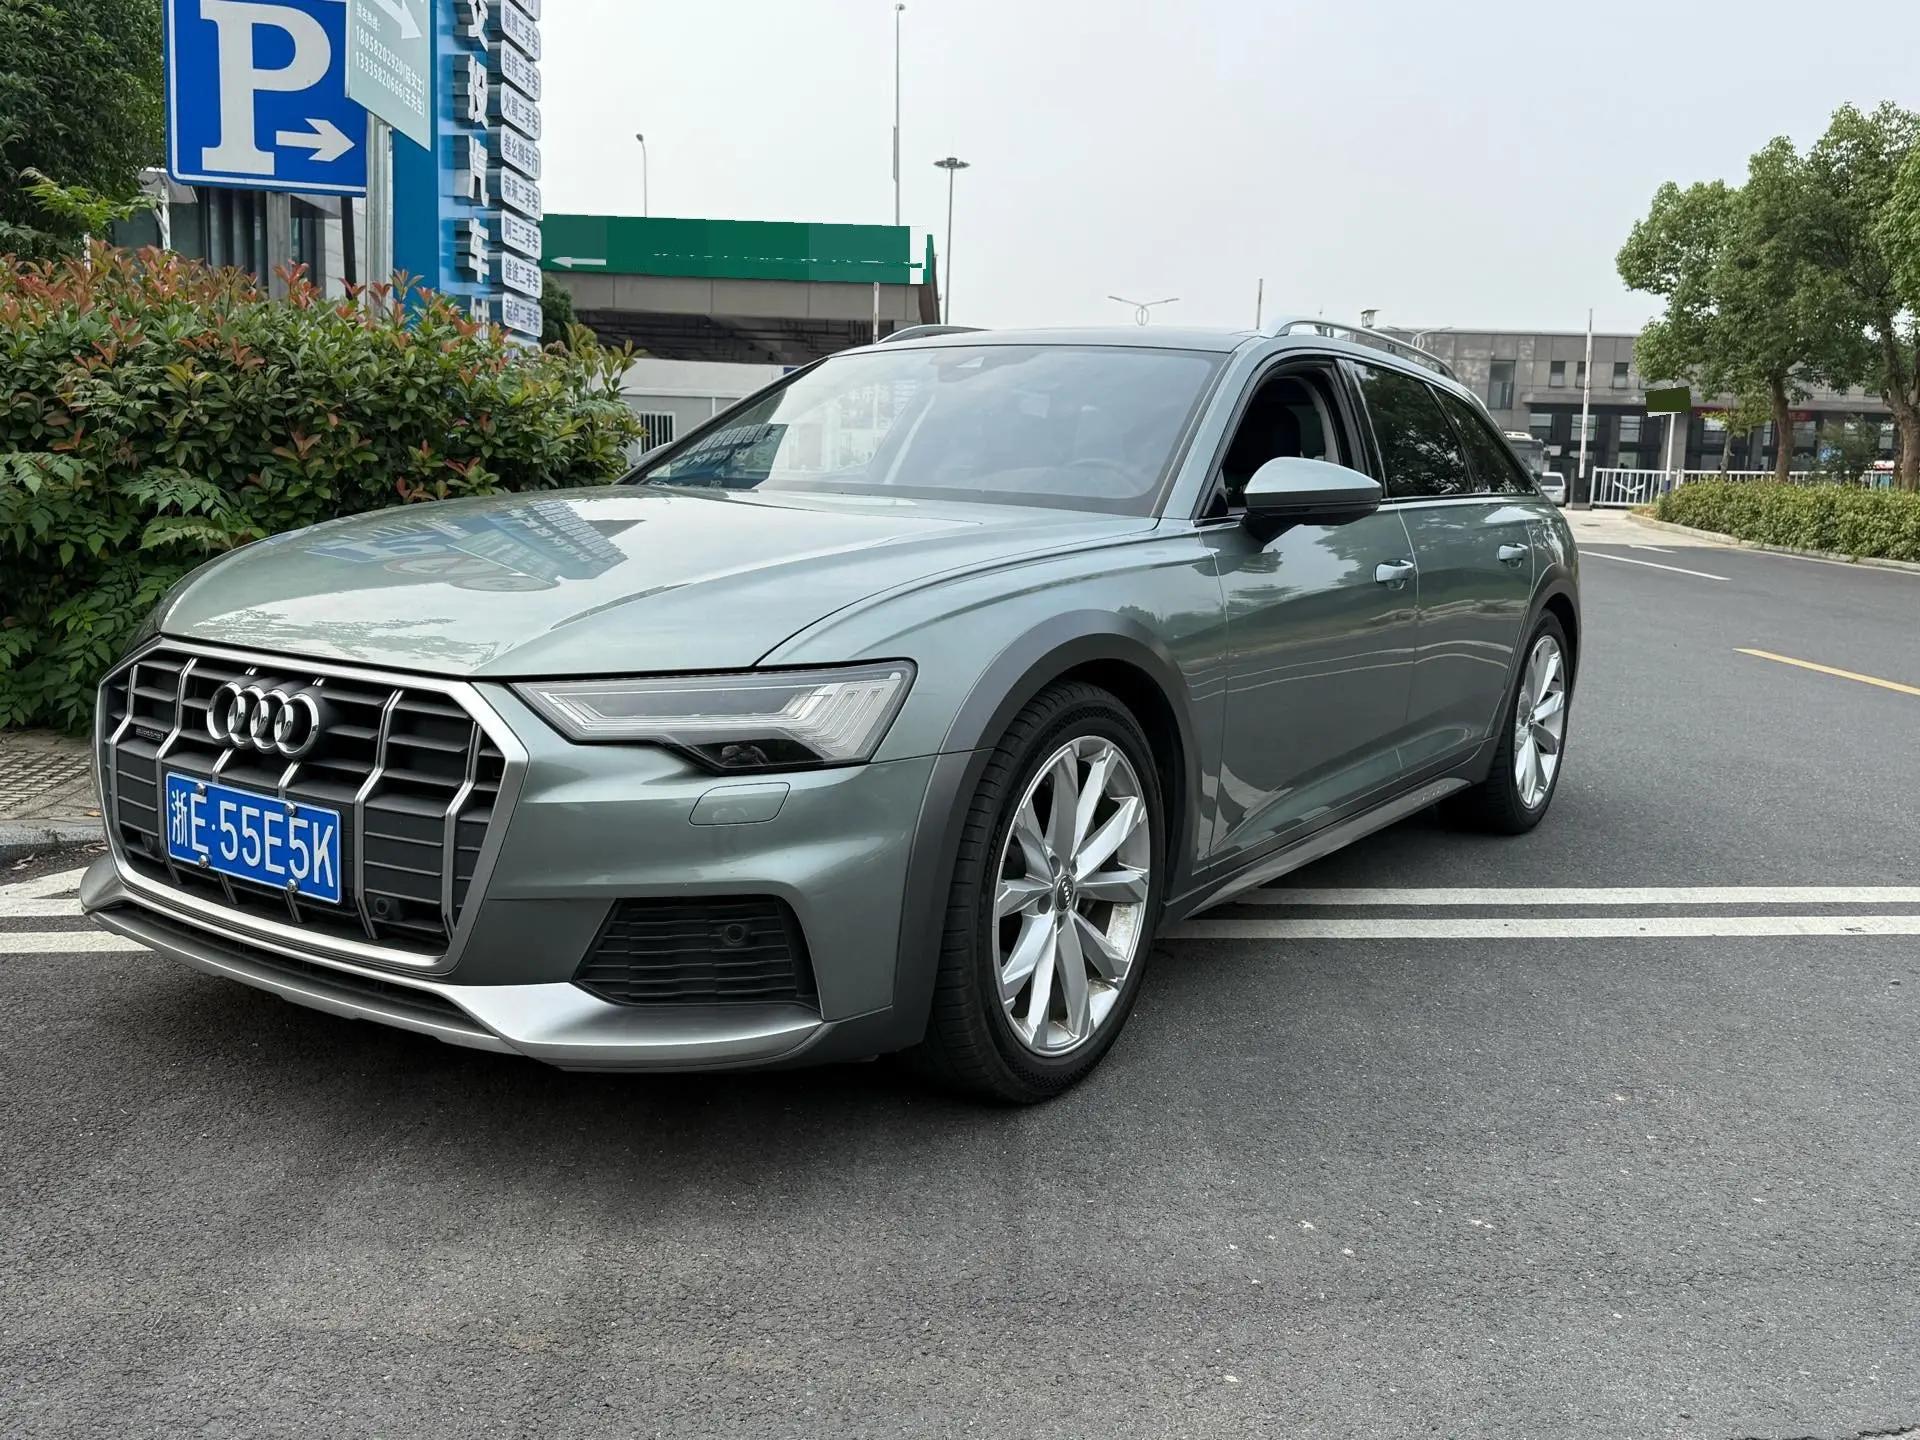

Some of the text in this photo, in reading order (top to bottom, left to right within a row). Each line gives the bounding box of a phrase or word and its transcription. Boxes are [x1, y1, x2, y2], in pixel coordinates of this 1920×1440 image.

[200, 0, 332, 176] P
[504, 91, 538, 132] 火哥二手车
[171, 788, 334, 888] 浙E·55E5K
